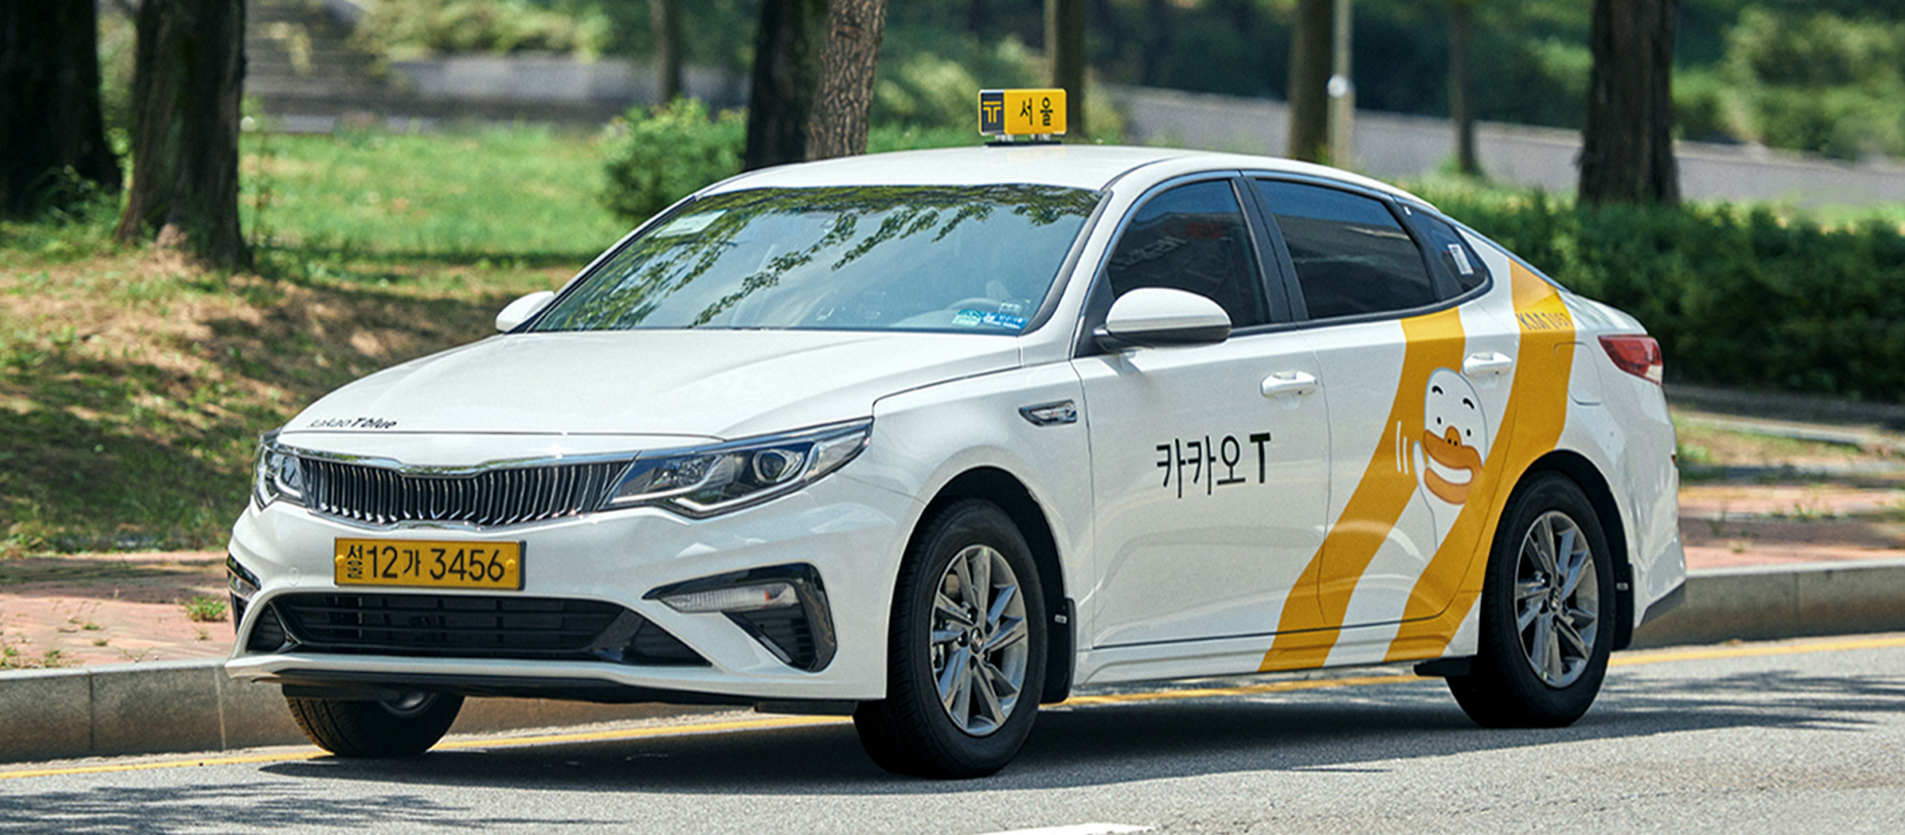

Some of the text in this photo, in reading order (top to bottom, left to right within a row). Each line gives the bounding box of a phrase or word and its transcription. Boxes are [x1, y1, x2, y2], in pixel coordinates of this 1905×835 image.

[1019, 97, 1054, 126] 서울
[1156, 432, 1271, 499] 카카오 T
[347, 544, 505, 582] 서울 12가 3456
